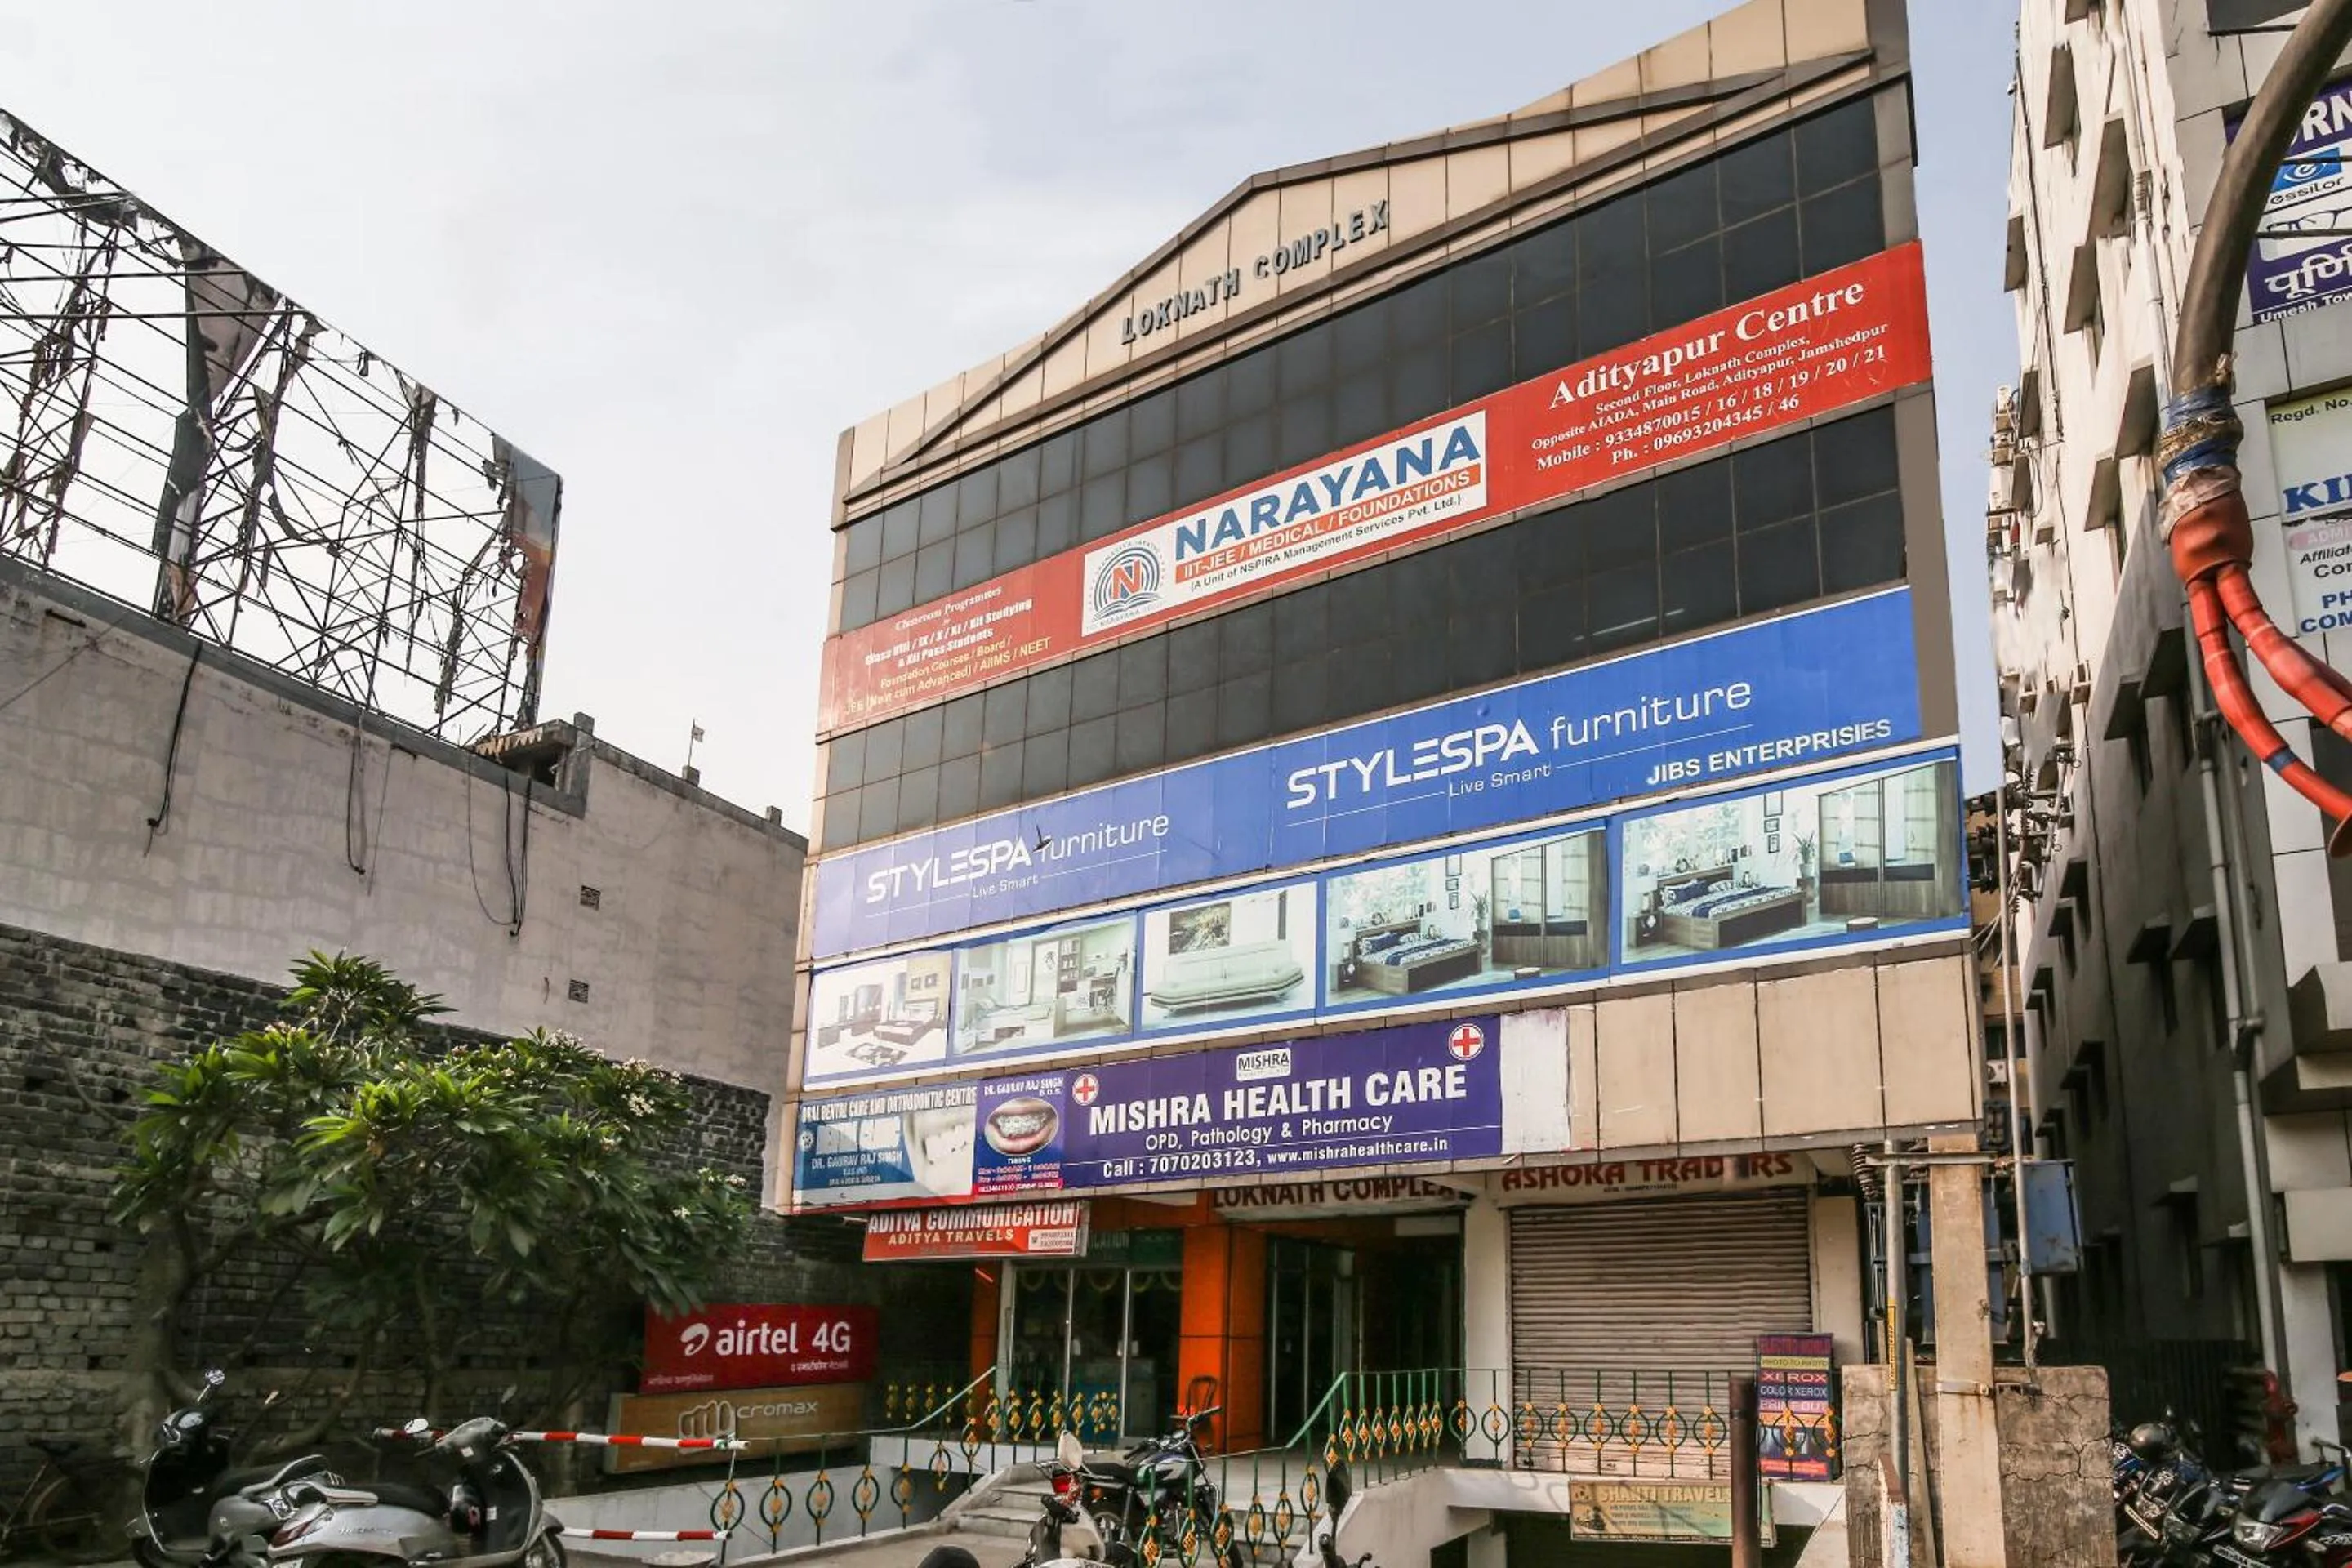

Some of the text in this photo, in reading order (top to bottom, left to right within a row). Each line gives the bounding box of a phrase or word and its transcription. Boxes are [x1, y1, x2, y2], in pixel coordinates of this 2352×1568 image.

[2290, 90, 2352, 145] RN
[1121, 199, 1388, 345] LOKNATH COMPLEX
[2260, 301, 2317, 323] Umesh
[1549, 283, 1864, 409] Adityapur Centre
[1532, 425, 1585, 450] Opposite
[1643, 395, 1677, 412] Main
[1681, 381, 1719, 400] Road,
[1722, 356, 1794, 386] Adityapur,
[1798, 324, 1888, 361] Jamshedpur
[1596, 336, 1810, 414] Second Floor, Loknath Complex,
[1537, 443, 1591, 471] Mobile
[1605, 405, 1701, 448] 9334870015
[1717, 395, 1737, 411] 16
[1753, 382, 1773, 399] 18
[1789, 371, 1810, 390] 19
[1826, 358, 1847, 377] 20
[1864, 345, 1885, 363] 21
[2271, 405, 2319, 425] Regd.
[1610, 447, 1638, 465] Ph.
[1653, 405, 1763, 451] 09693204345
[1778, 394, 1800, 412] 46
[1175, 425, 1481, 561] NARAYANA
[1184, 550, 1236, 578] IIT-JEE
[1249, 523, 1324, 555] MEDICAL
[1338, 470, 1471, 528] FOUNDATIONS
[1204, 572, 1224, 586] Unit
[1227, 568, 1237, 579] of
[1240, 553, 1281, 574] NSPIRA
[1283, 532, 1352, 559] Management
[1356, 515, 1405, 537] Services
[1408, 506, 1431, 519] Pvt.
[2300, 544, 2352, 564] Affiliat
[1019, 636, 1052, 657] NEET
[1287, 681, 1751, 809] STYLESPA furniture
[1646, 719, 1893, 786] JIBS ENTERPRISIES
[1449, 763, 1551, 797] Live Smart
[866, 814, 1170, 904] STYLESPA furniture
[972, 873, 1039, 898] Live Smart
[1238, 1052, 1290, 1071] MISHRA
[1089, 1064, 1467, 1136] MISHRA HEALTH CARE
[1145, 1114, 1393, 1151] OPD, Pathology & Pharmacy
[1103, 1160, 1134, 1178] Call
[1150, 1148, 1262, 1174] 7070203123,
[1267, 1136, 1448, 1165] www.mishrahealthcare.in
[1502, 1152, 1794, 1192] ASHOKA TRADRS
[1213, 1183, 1325, 1208] LOKNATH
[868, 1203, 1075, 1233] ADITYA COMMUNICATION
[889, 1228, 1015, 1245] ADITYA TRAVELS
[716, 1320, 851, 1356] airtel 4G
[1794, 1387, 1828, 1398] XEROX
[1601, 1486, 1731, 1503] SHANTI TRAVEL
